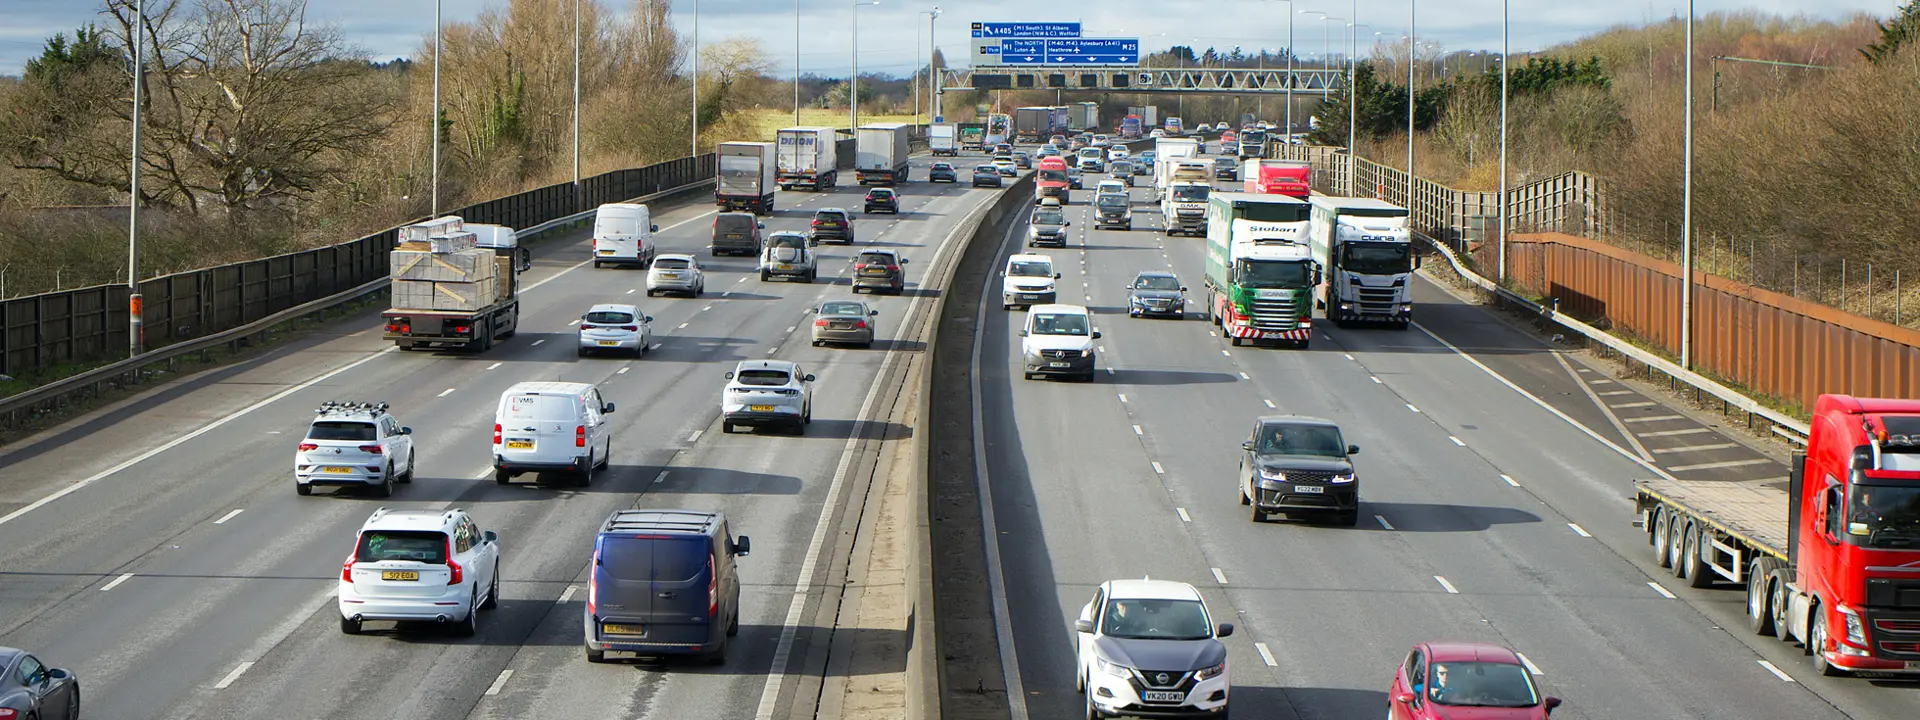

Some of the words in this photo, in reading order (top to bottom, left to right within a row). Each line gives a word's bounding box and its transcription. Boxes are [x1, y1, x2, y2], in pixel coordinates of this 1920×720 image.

[1122, 43, 1137, 51] M25
[1249, 225, 1297, 233] Stobart
[1146, 692, 1167, 700] VK20
[1167, 692, 1183, 700] GWU
